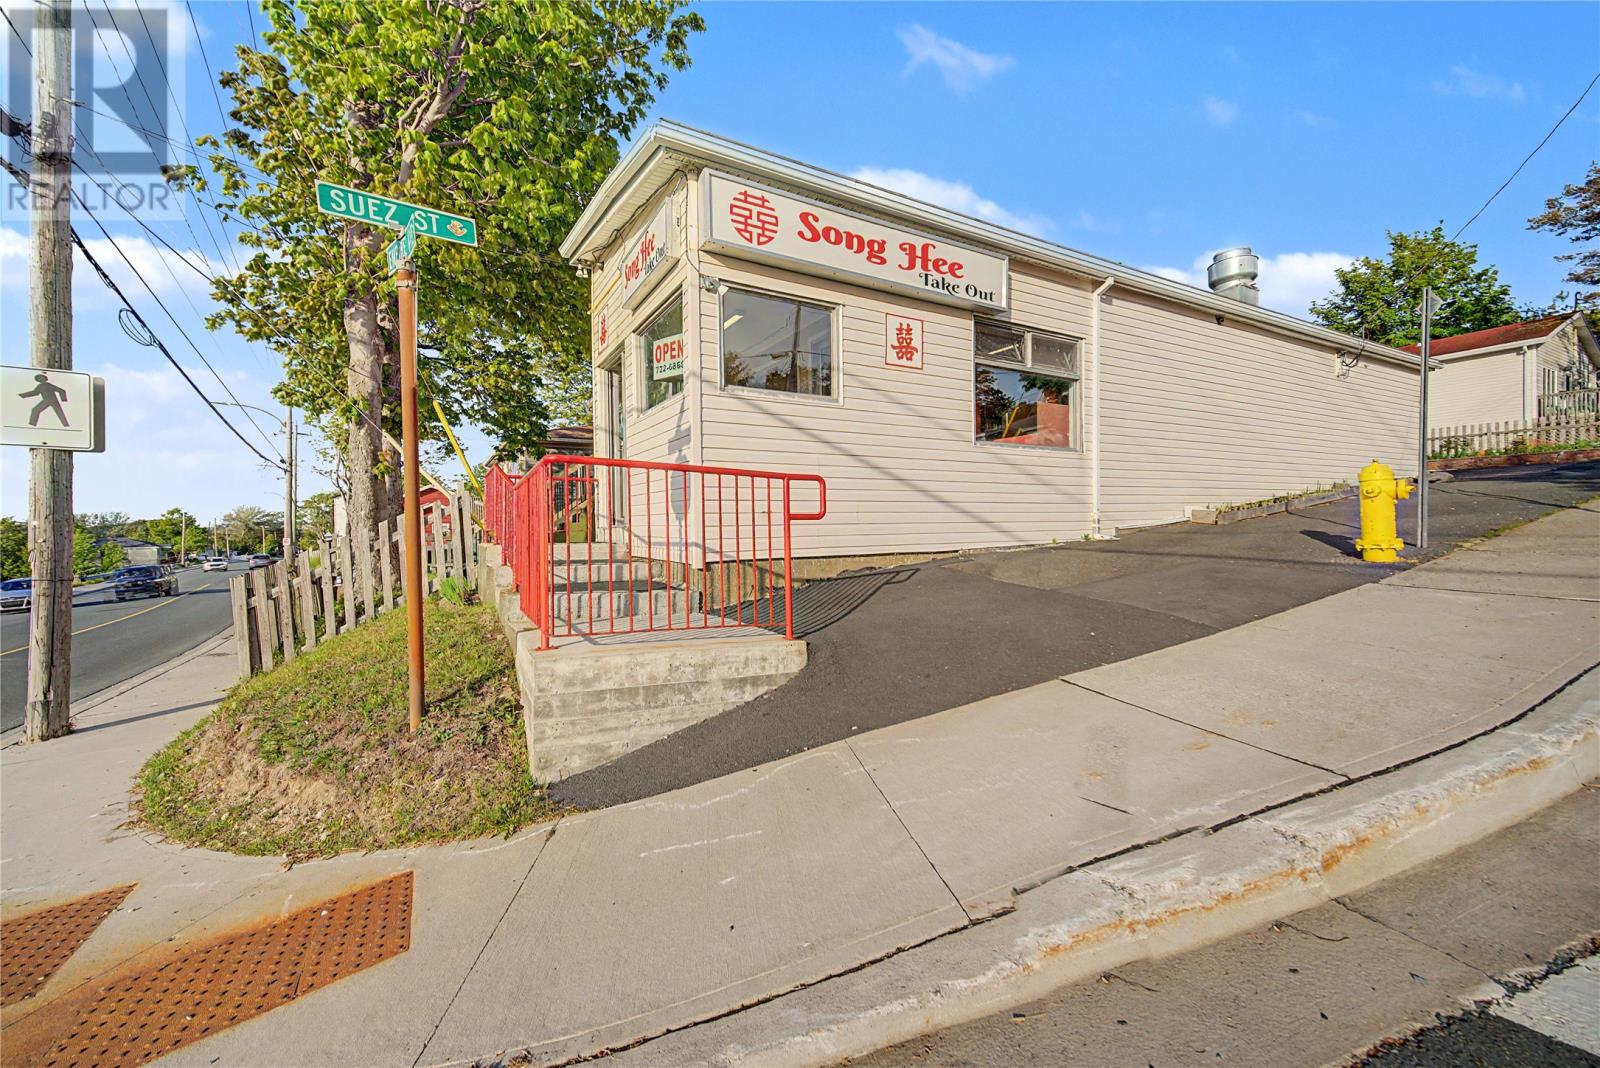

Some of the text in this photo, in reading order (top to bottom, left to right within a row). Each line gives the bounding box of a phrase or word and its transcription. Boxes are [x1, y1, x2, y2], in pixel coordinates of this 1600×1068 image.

[330, 189, 440, 233] SUEZ ST
[797, 211, 964, 278] Song Hee
[919, 273, 996, 302] Take Out
[655, 339, 684, 363] OPEN
